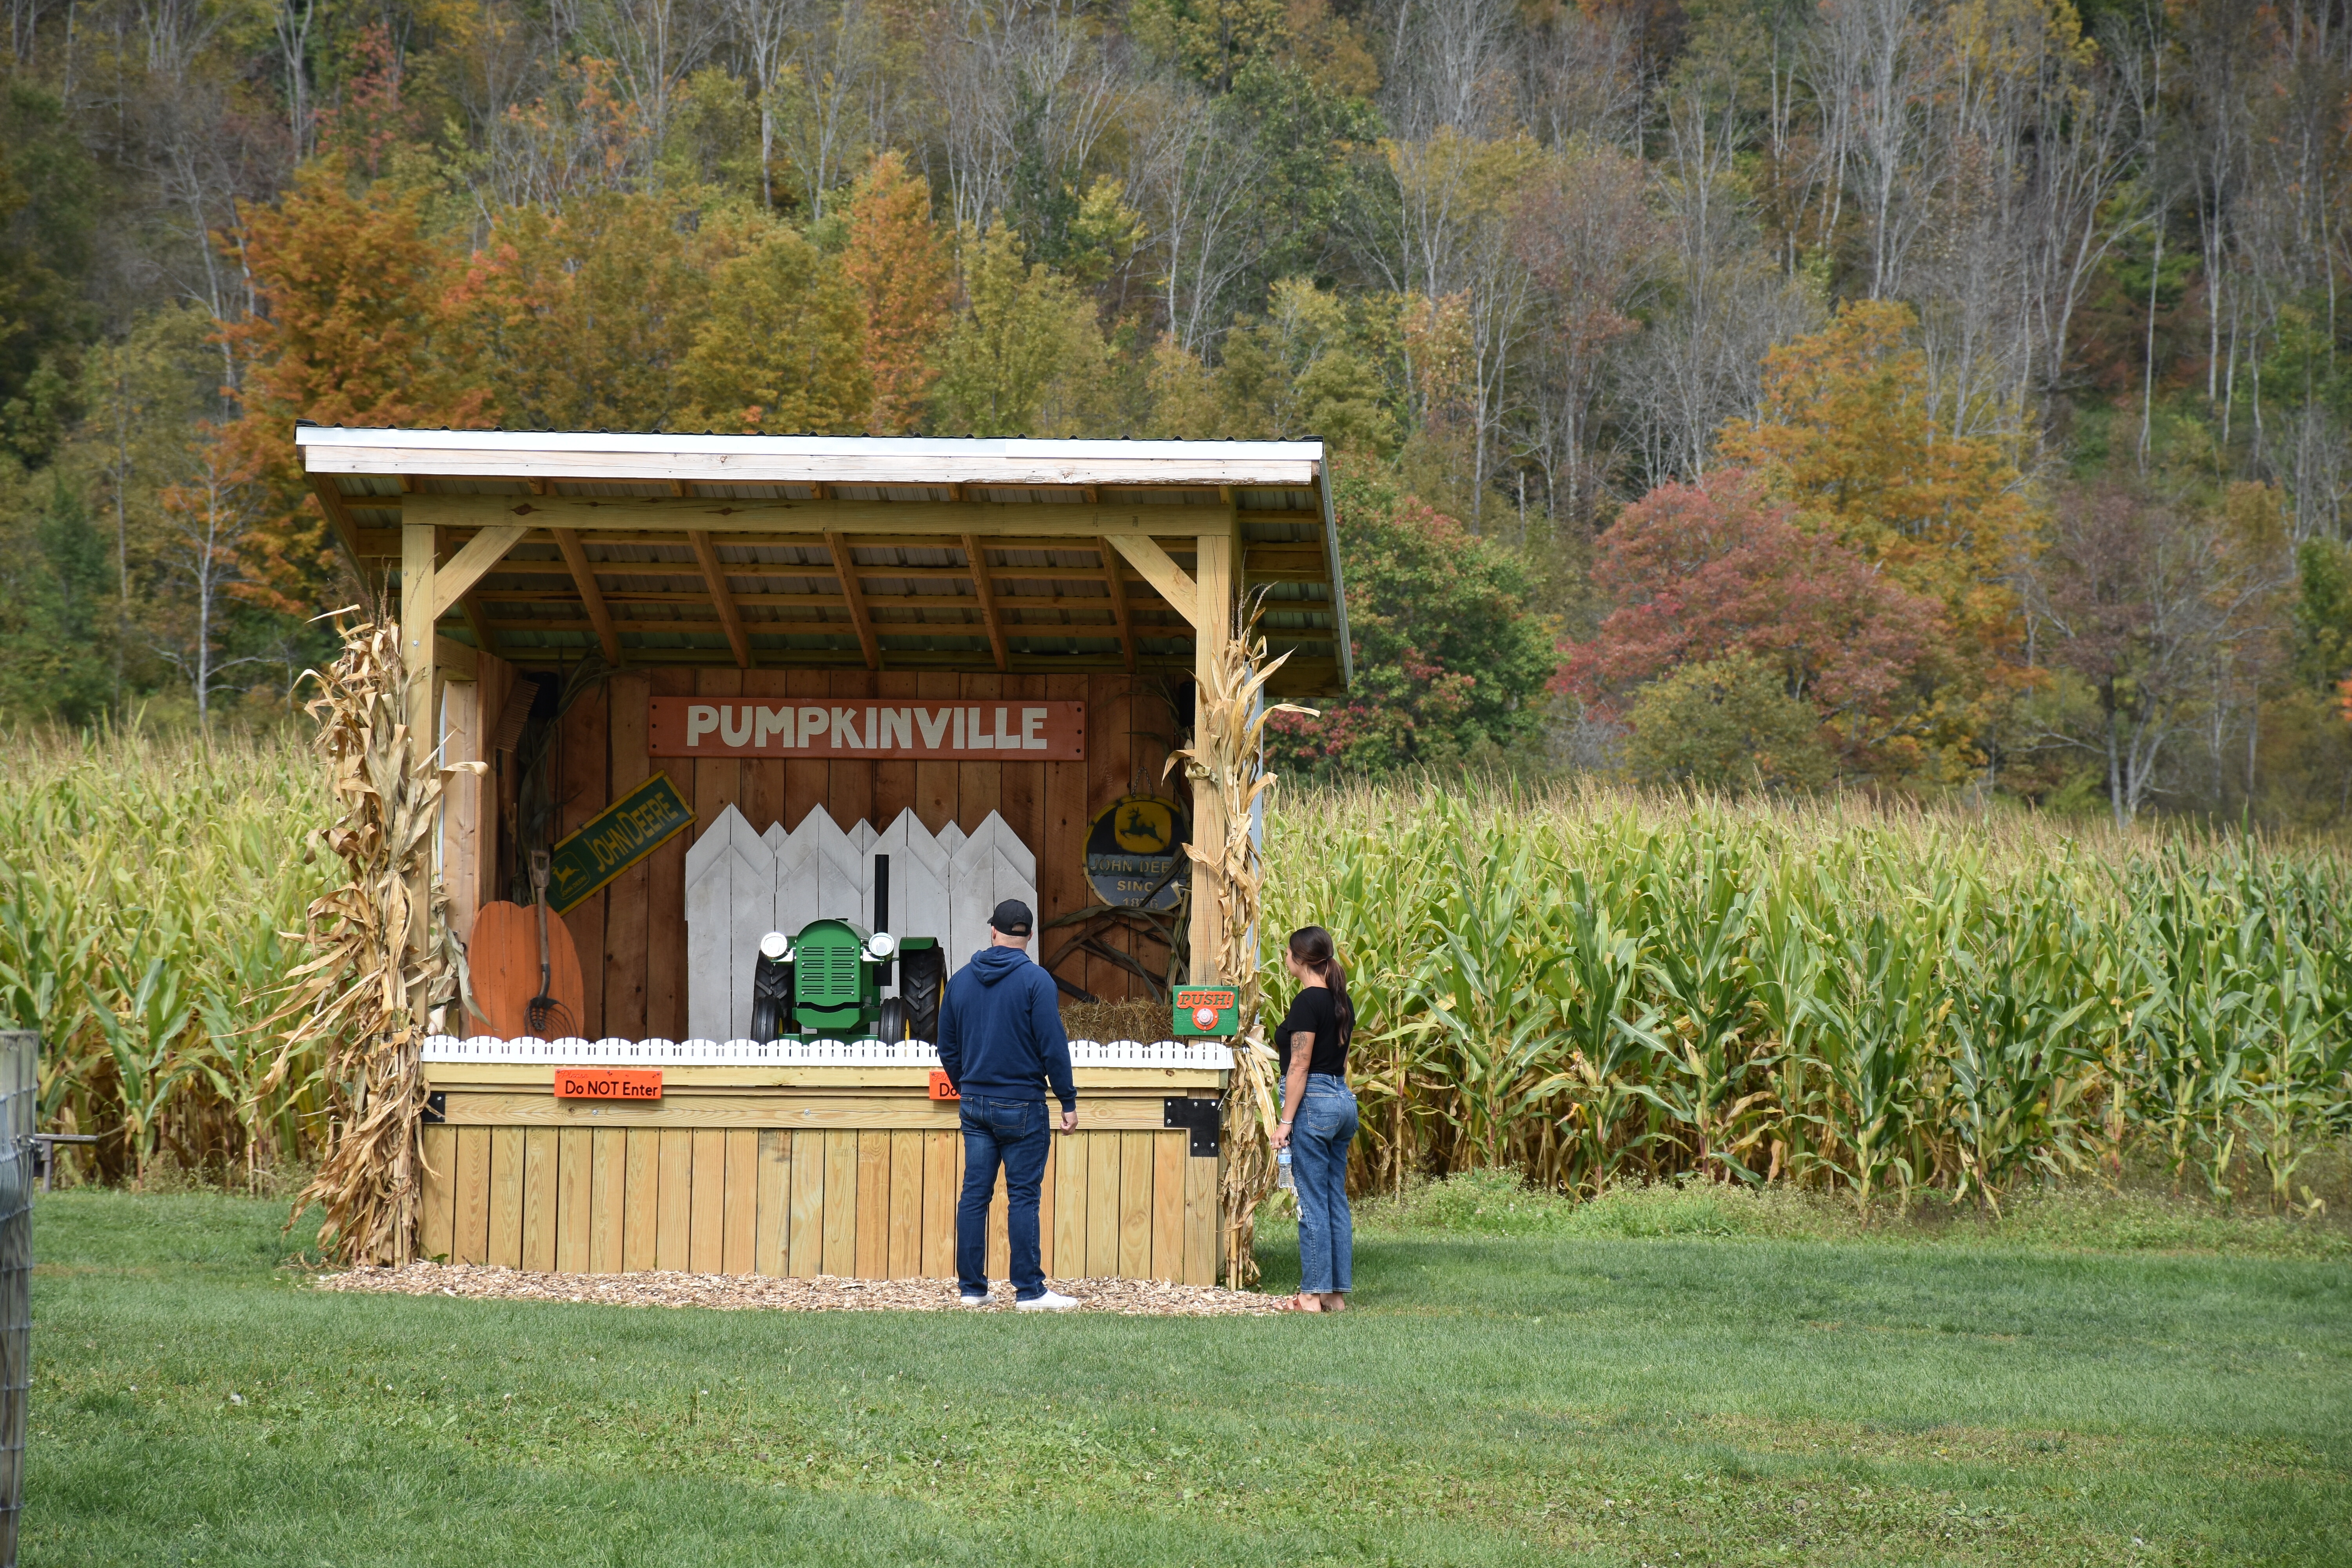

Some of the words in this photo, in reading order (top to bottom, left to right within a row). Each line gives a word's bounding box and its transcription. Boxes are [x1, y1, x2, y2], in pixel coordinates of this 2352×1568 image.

[687, 705, 1047, 749] PUMPKINVILLE
[584, 824, 635, 873] JOHN
[616, 791, 679, 845] DEERE
[1090, 858, 1132, 872] JOHN
[561, 886, 573, 897] JOHN
[1117, 880, 1163, 893] SINC
[1122, 897, 1158, 909] 186
[1180, 994, 1232, 1006] PUSH!
[559, 1070, 588, 1079] Please
[932, 1073, 949, 1082] Ple
[565, 1080, 584, 1094] Do
[588, 1081, 619, 1095] NOT
[623, 1082, 658, 1096] Enter
[940, 1083, 958, 1096] Do
